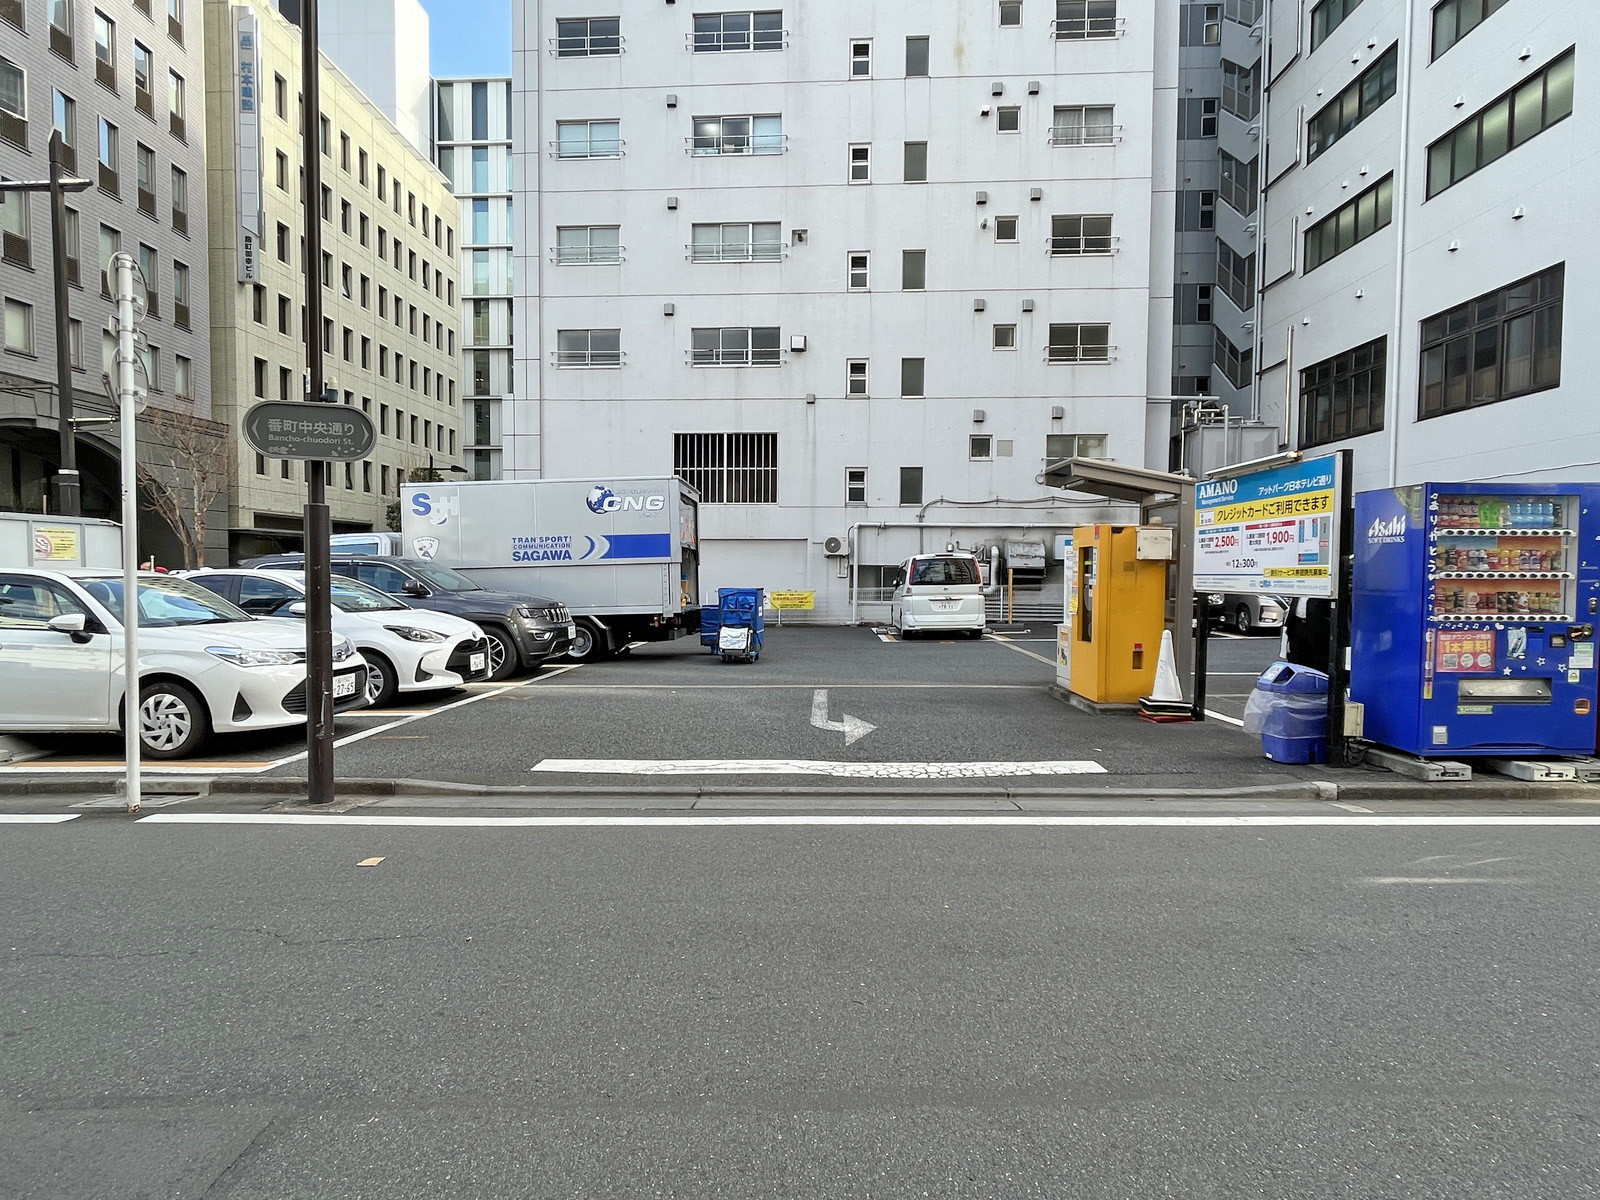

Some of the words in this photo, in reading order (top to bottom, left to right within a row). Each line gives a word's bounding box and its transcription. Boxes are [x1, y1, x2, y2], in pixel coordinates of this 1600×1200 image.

[267, 418, 355, 436] 番町中央通り
[268, 434, 340, 445] Bancho-chuodori
[343, 438, 354, 446] St.
[1198, 478, 1238, 499] AMANO
[1258, 474, 1332, 496] アットパーク日本テレビ通り
[602, 495, 665, 511] CNG
[1217, 495, 1330, 522] クレジットカードご利用できます
[1368, 514, 1406, 537] Asahi
[513, 542, 571, 550] COMMUNICATION
[1214, 535, 1239, 549] 2,500円
[1266, 530, 1295, 546] 1,900円
[512, 549, 572, 562] SAGAWA
